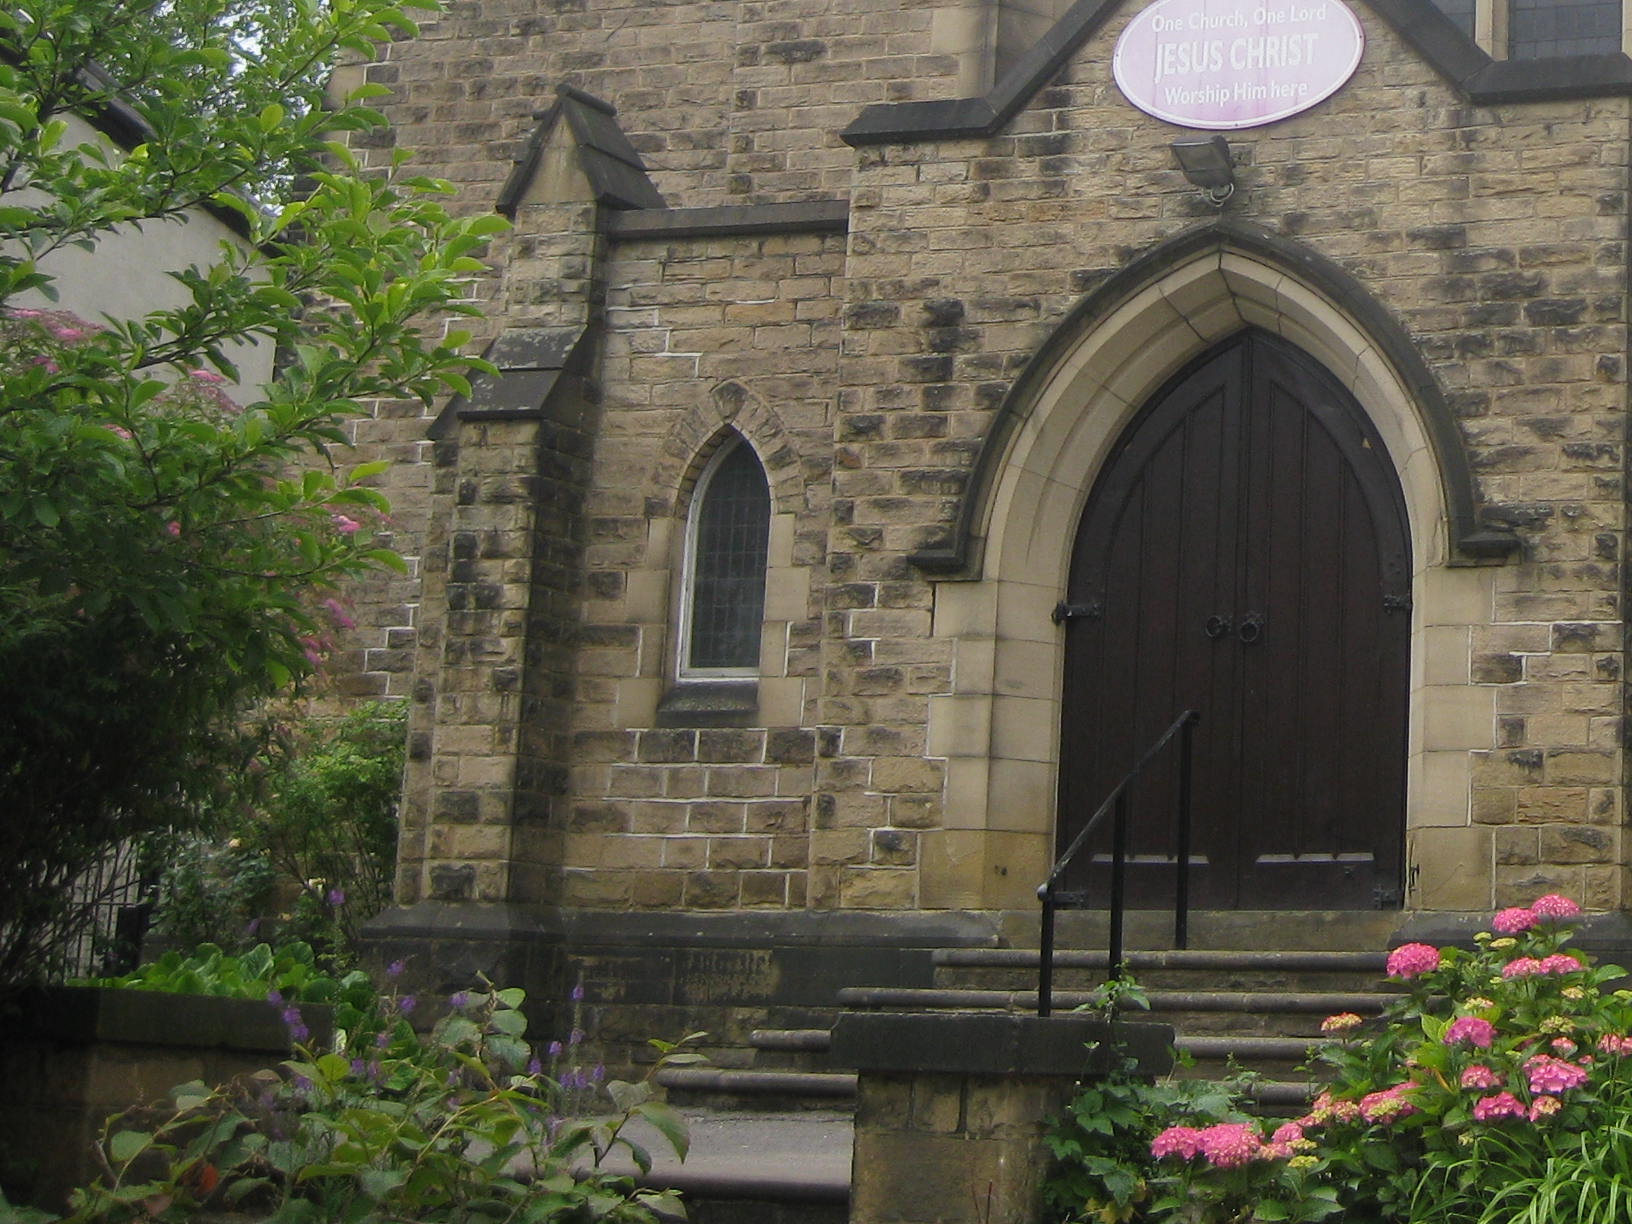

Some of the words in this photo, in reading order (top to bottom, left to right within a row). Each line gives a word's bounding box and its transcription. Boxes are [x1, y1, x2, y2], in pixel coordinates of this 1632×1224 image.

[1152, 15, 1183, 32] One
[1189, 9, 1248, 29] Church,
[1254, 8, 1286, 24] One
[1290, 4, 1327, 22] Lord
[1154, 39, 1223, 84] JESUS
[1230, 33, 1319, 70] CHRIST
[1164, 84, 1230, 107] Worship
[1233, 82, 1266, 101] Him
[1270, 80, 1309, 98] here
